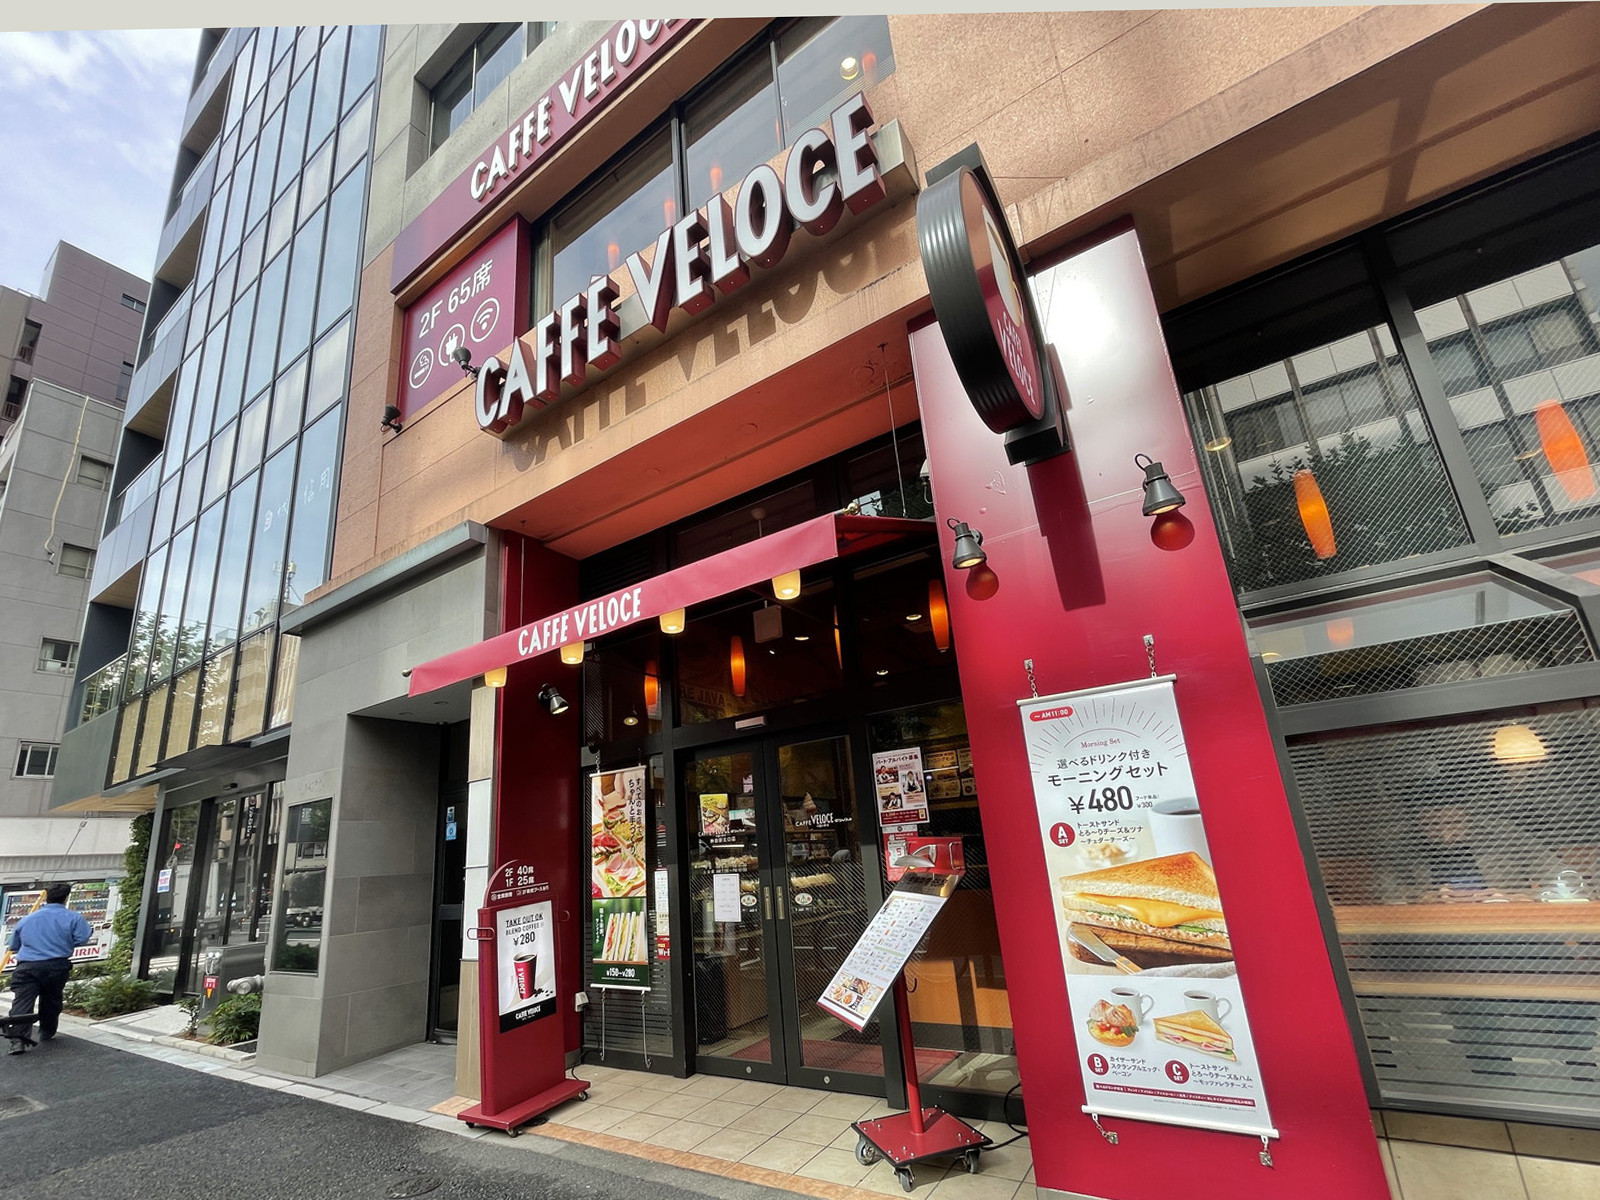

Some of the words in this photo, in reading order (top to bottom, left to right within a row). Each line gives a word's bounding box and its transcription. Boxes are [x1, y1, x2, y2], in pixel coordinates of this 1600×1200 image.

[558, 19, 678, 117] VELOC
[626, 90, 887, 334] VELOCE
[419, 299, 444, 339] 2F
[447, 259, 493, 314] 65席
[574, 587, 642, 637] VELOCE
[1080, 740, 1108, 749] Morning
[1109, 737, 1121, 746] Set
[1056, 748, 1151, 770] 選べるドリンク付き
[1047, 761, 1168, 788] モーニングセット
[1068, 785, 1134, 814] ¥480
[811, 812, 835, 825] VELOCE
[1077, 819, 1120, 829] トーストサンド
[1056, 825, 1068, 838] A
[504, 868, 514, 877] 2F
[505, 878, 514, 888] 1F
[505, 917, 521, 928] TAKE
[522, 914, 534, 925] OUT
[505, 926, 522, 936] BLEND
[522, 922, 540, 932] COFFEE
[74, 946, 100, 957] IRIN
[1093, 1056, 1103, 1068] B
[1189, 1062, 1230, 1072] トーストサンド
[1171, 1063, 1182, 1076] C
